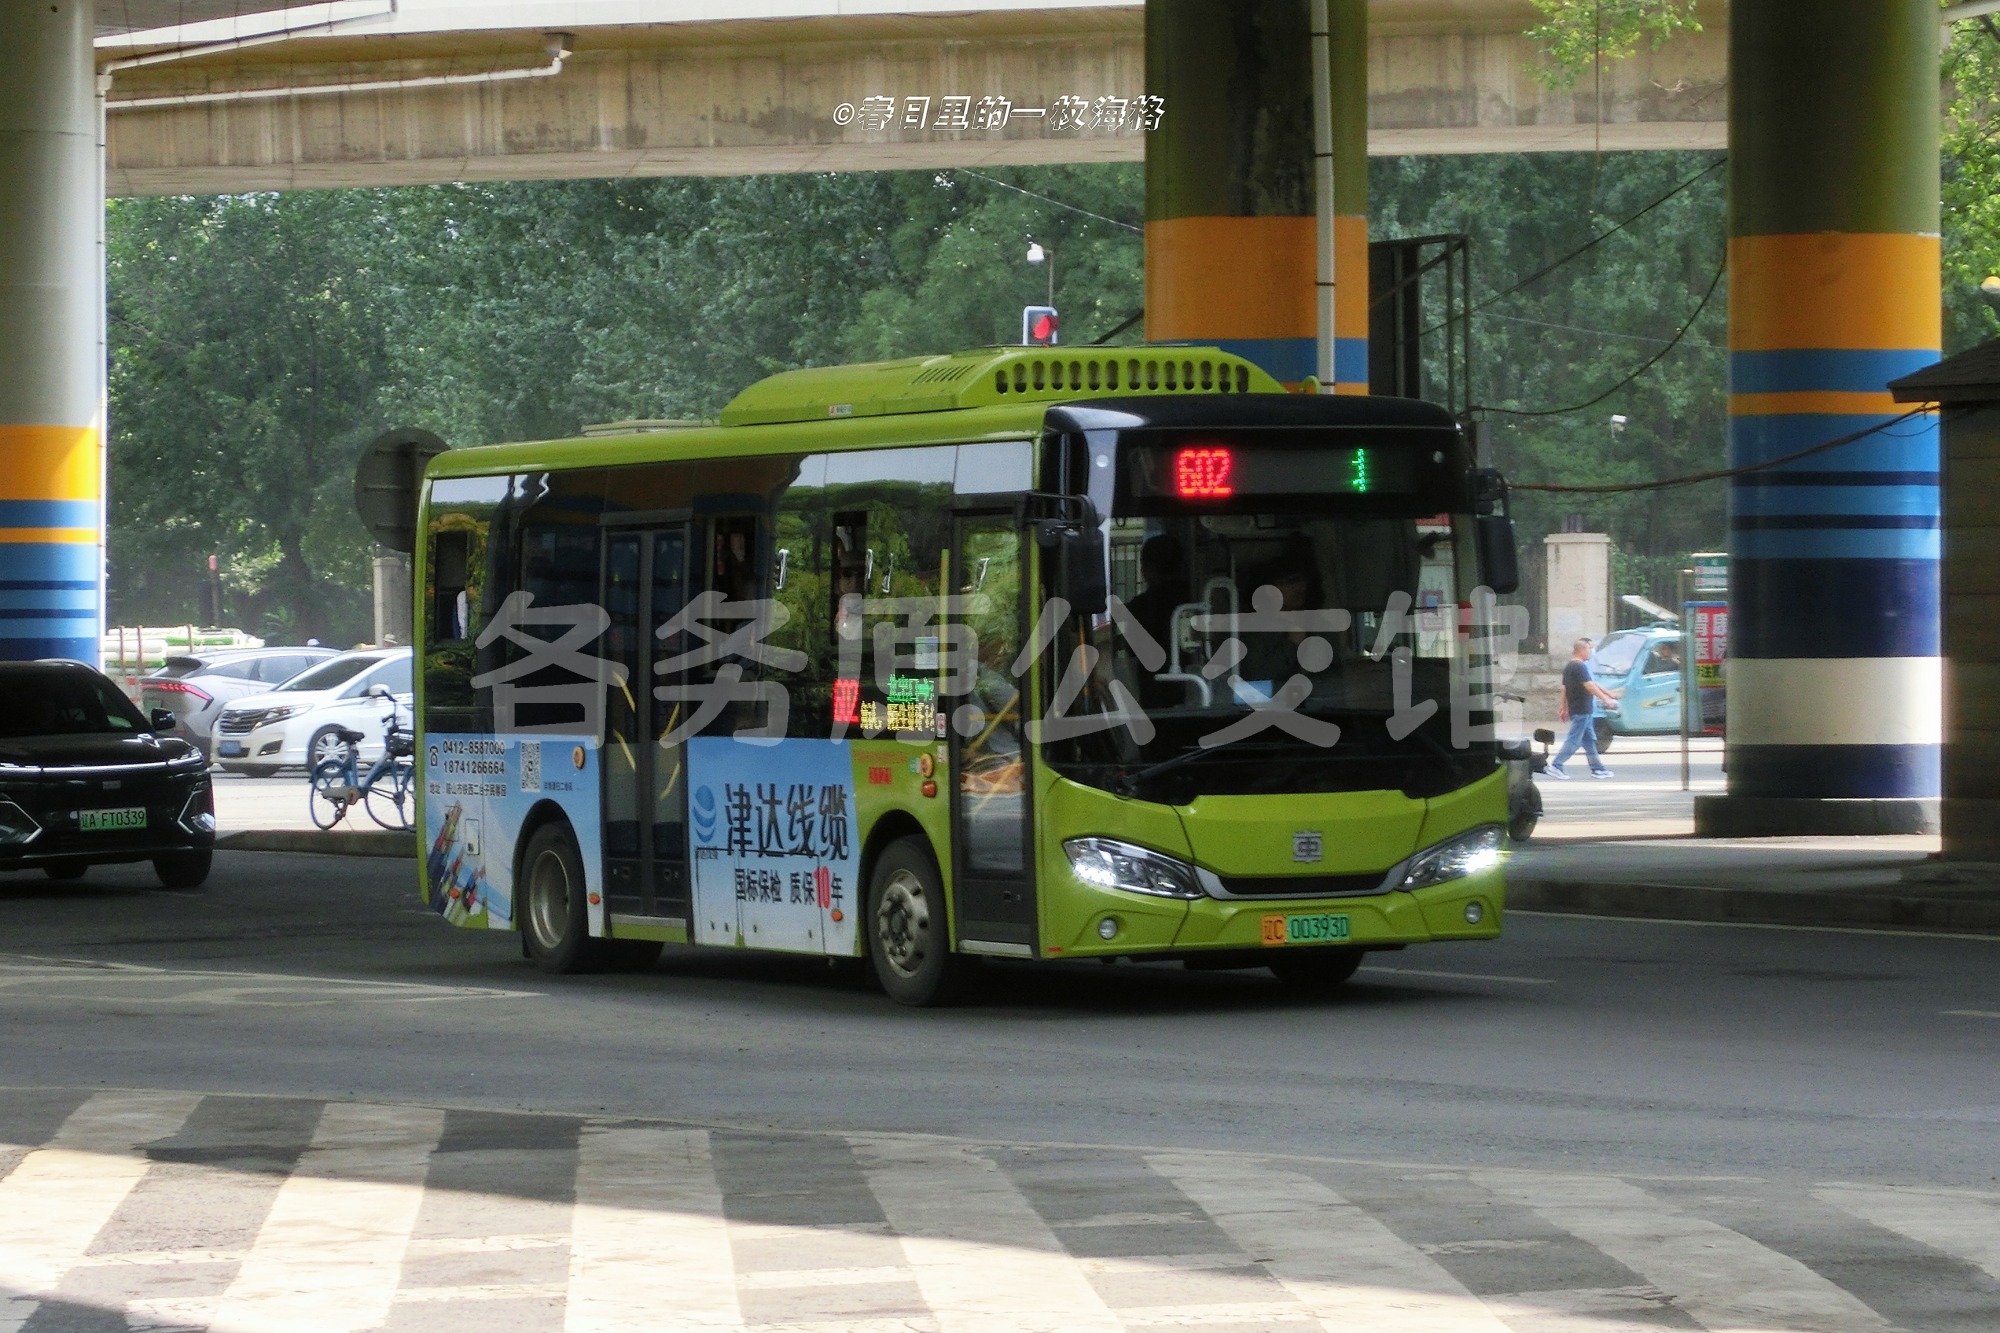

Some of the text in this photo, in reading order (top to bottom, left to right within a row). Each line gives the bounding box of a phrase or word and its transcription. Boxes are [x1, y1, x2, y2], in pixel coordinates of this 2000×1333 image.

[1177, 448, 1233, 496] 602
[443, 740, 505, 755] 0412-8587000
[444, 761, 505, 775] 18741266664
[724, 783, 849, 860] 津达线缆
[735, 866, 844, 909] 国标保检 质保10年
